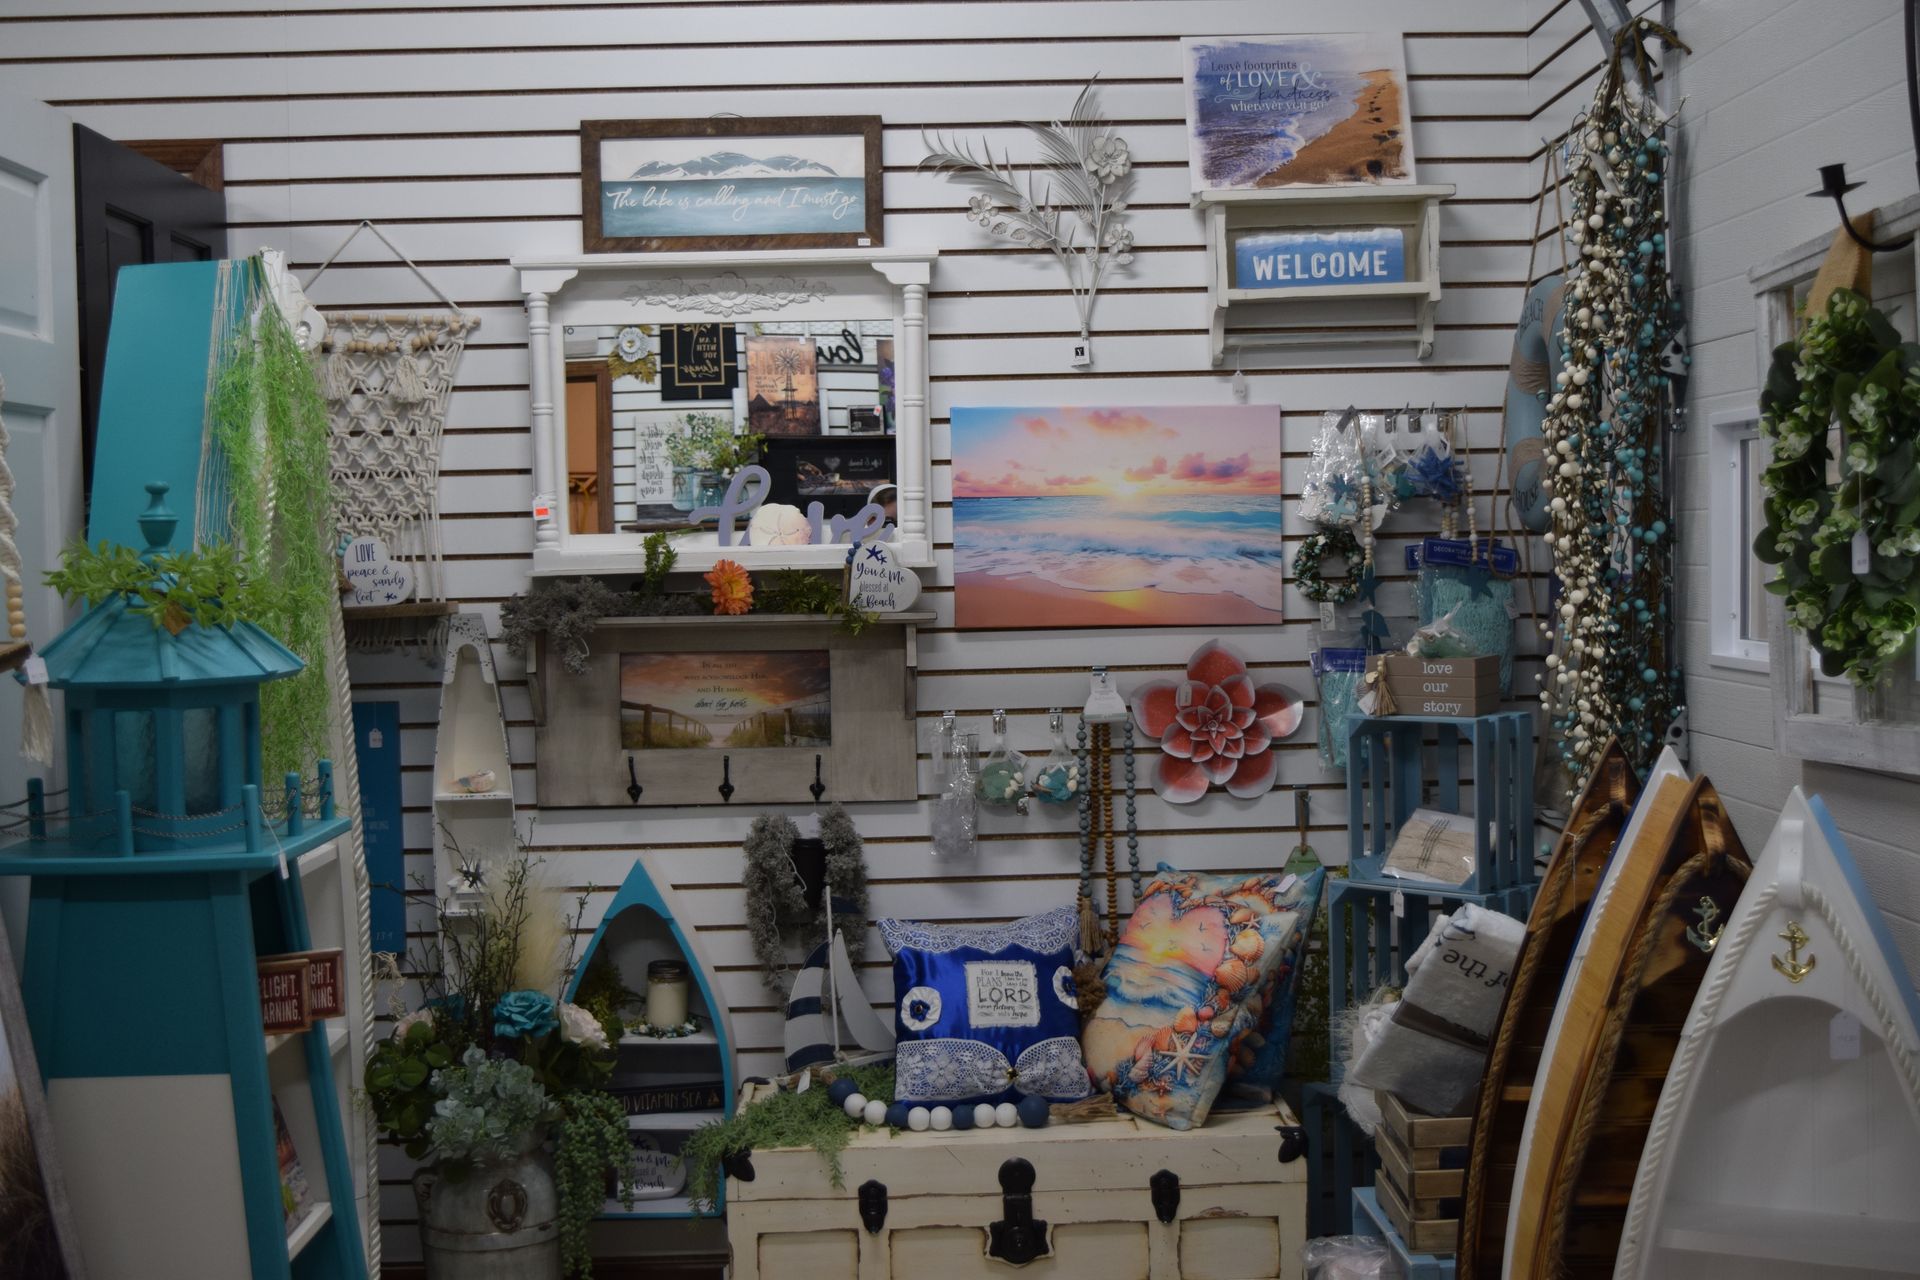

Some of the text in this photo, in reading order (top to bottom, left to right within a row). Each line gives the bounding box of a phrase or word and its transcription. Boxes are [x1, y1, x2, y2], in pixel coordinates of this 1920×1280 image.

[1211, 60, 1297, 72] Leave footprints
[1220, 62, 1327, 91] of LOVE &
[1258, 79, 1335, 104] kindness
[1230, 100, 1284, 112] wherever
[1285, 101, 1307, 112] you
[606, 185, 857, 222] The lake is calling and I must go
[1251, 250, 1388, 281] WELCOME
[355, 543, 377, 563] LOVE
[347, 565, 390, 581] peace &
[372, 570, 405, 590] sandy
[854, 562, 905, 585] You & Me
[355, 589, 381, 604] feet
[866, 592, 896, 610] Beach
[1422, 662, 1453, 674] love
[1422, 681, 1449, 693] our
[1423, 700, 1462, 716] story
[1442, 949, 1488, 978] the
[310, 962, 334, 986] GHT.
[976, 976, 1003, 987] PLANS
[261, 974, 299, 999] LIGHT.
[978, 988, 1031, 1003] LORD
[311, 985, 336, 1010] NING.
[263, 998, 303, 1025] ARNING.
[633, 1089, 680, 1113] VITAMIN
[681, 1089, 703, 1109] SEA
